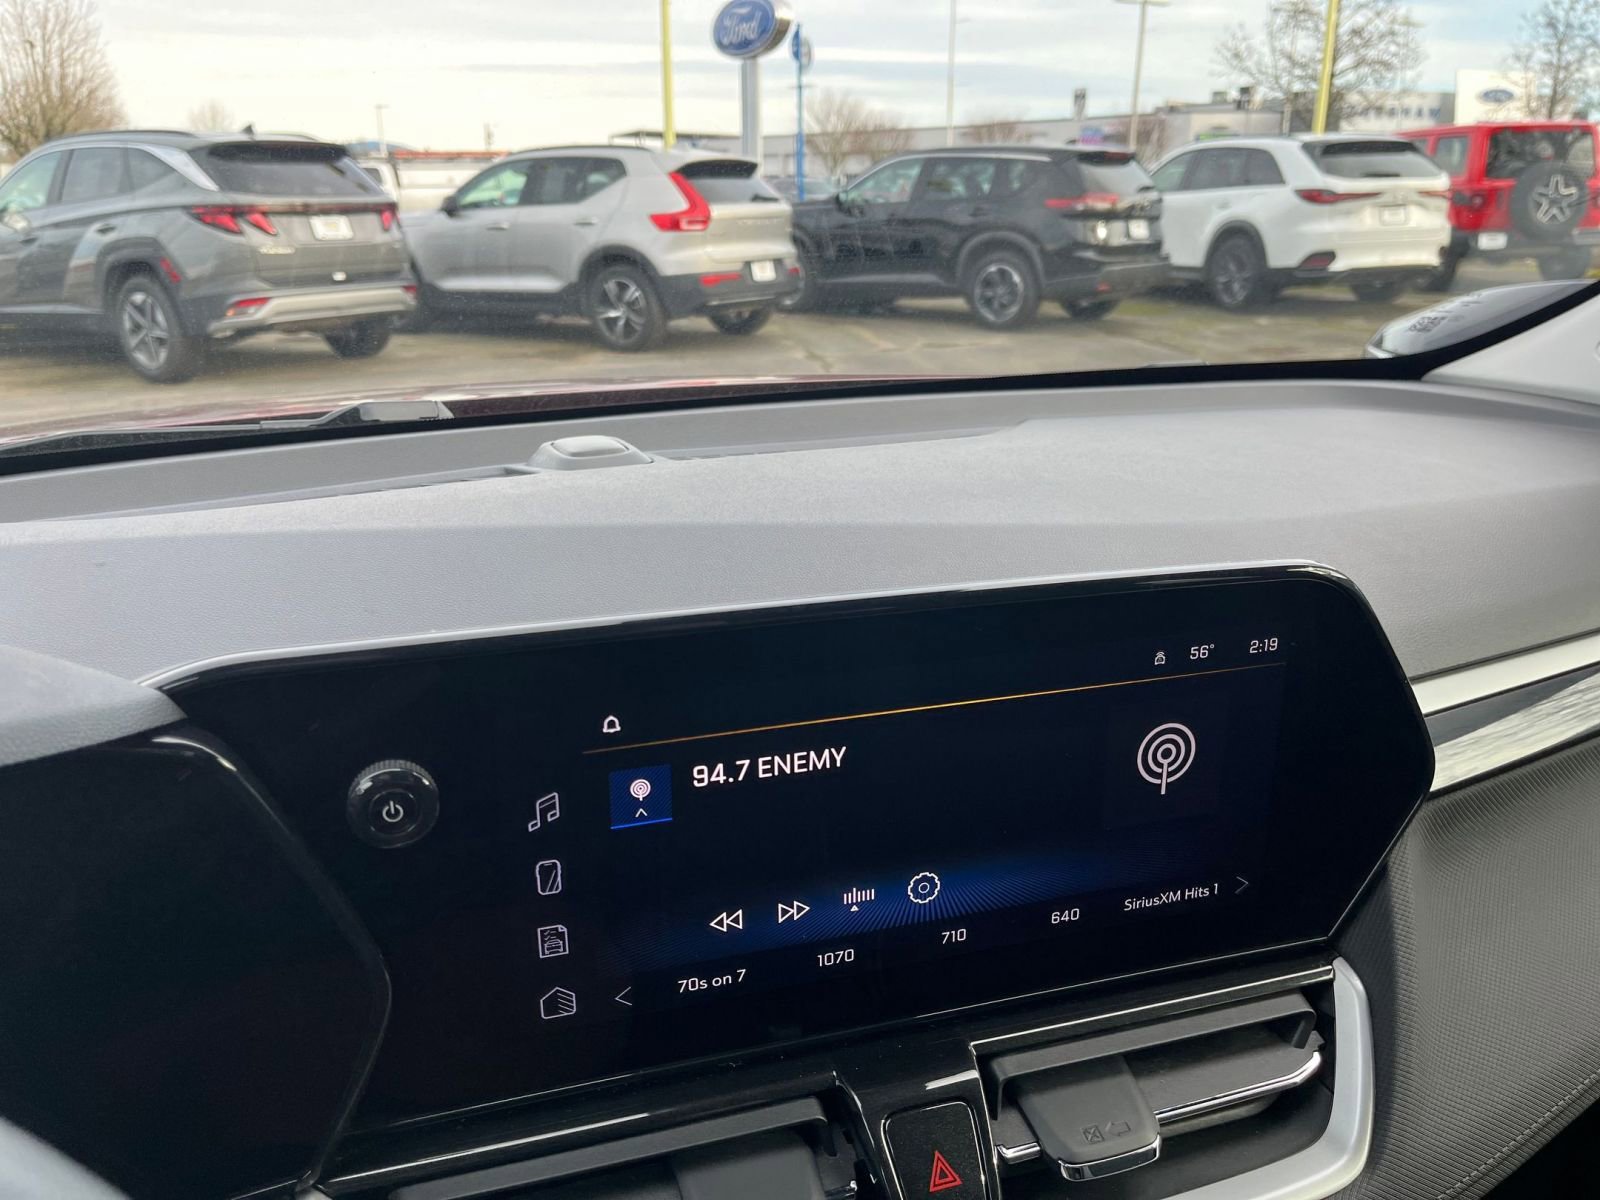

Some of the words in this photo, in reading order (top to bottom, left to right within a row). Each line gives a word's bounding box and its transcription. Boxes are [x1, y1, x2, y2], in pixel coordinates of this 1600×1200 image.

[720, 6, 763, 46] Ford
[1189, 643, 1215, 660] 56°
[1249, 637, 1279, 654] 2:19
[692, 759, 751, 788] 94.7
[757, 746, 847, 779] ENEMY
[1123, 889, 1181, 911] SiriusXM
[1184, 886, 1210, 900] Hits
[1213, 883, 1219, 895] 1
[1050, 908, 1081, 924] 640
[941, 928, 968, 944] 710
[816, 948, 855, 967] 1070
[677, 977, 708, 993] 70s
[711, 974, 733, 988] on
[736, 968, 747, 983] 7
